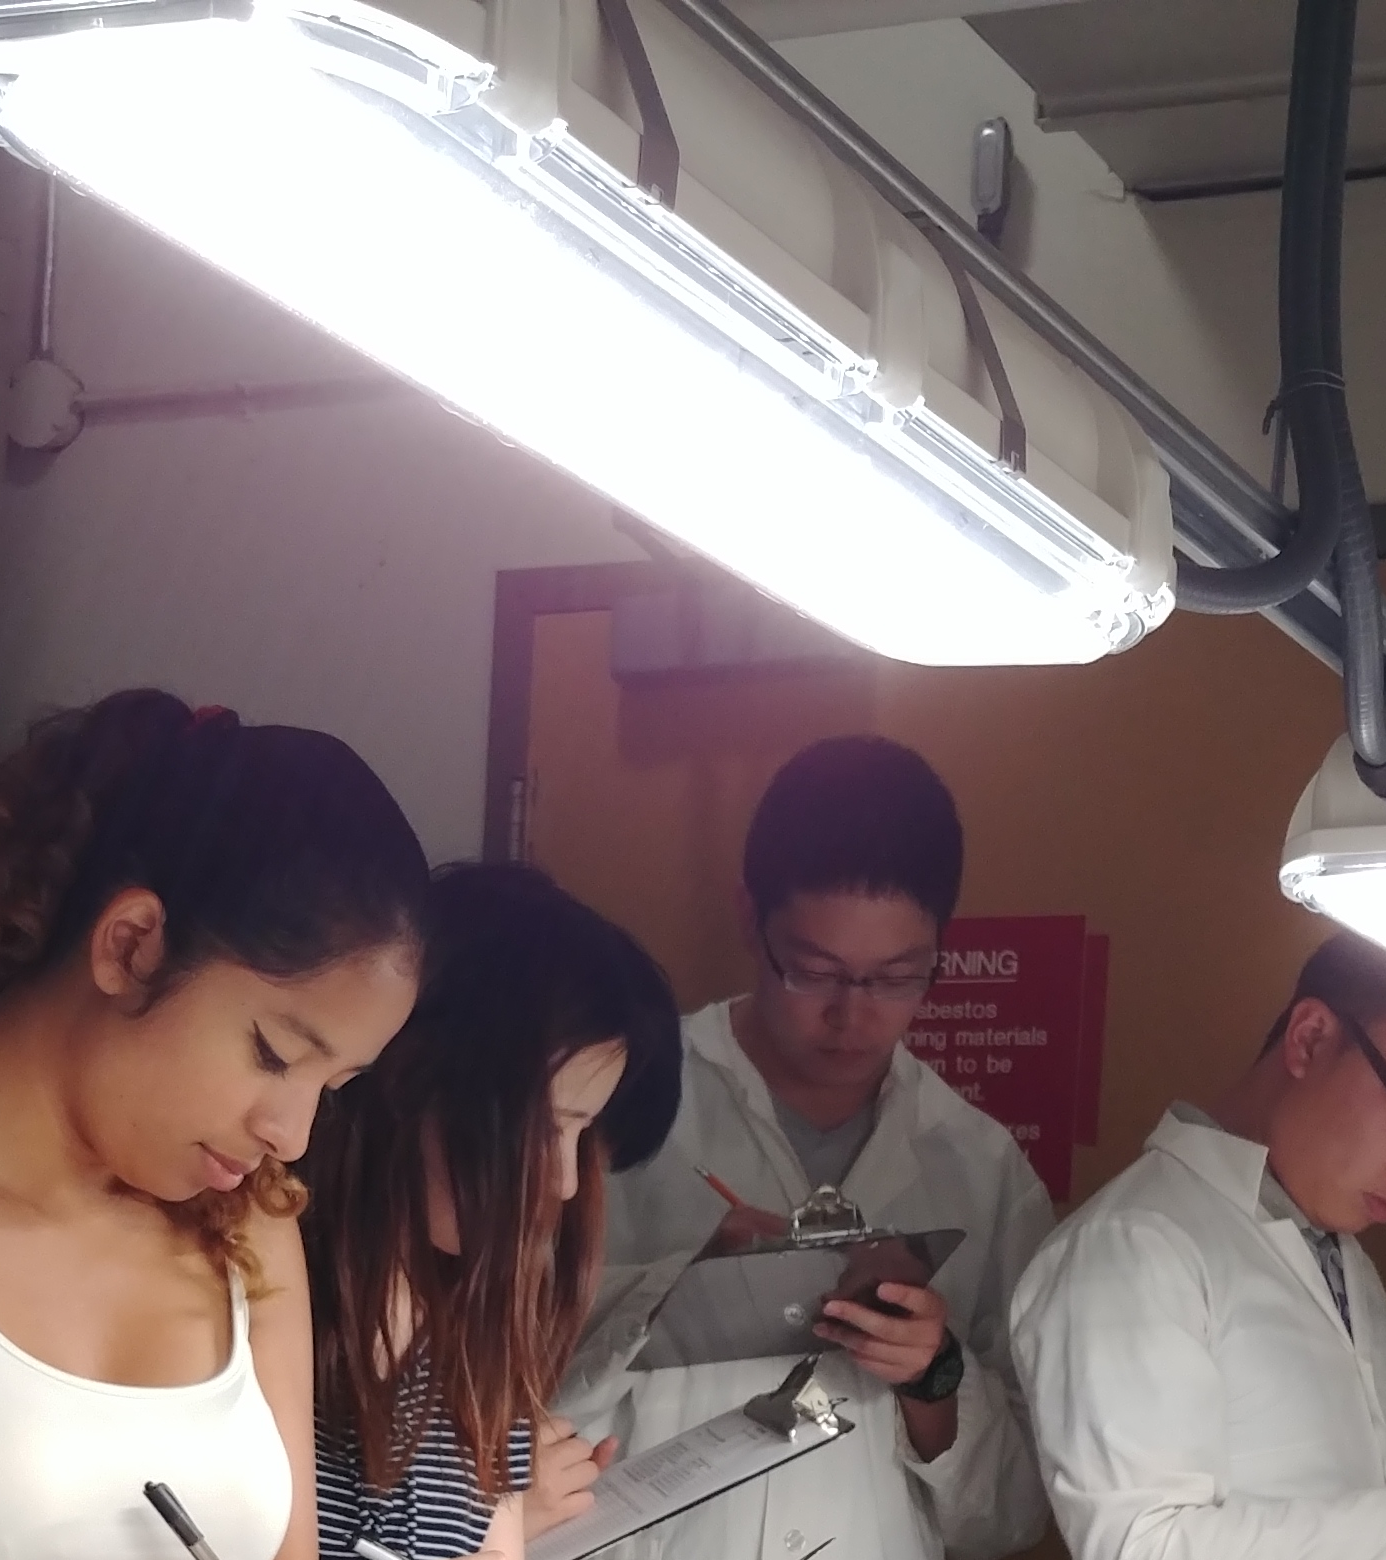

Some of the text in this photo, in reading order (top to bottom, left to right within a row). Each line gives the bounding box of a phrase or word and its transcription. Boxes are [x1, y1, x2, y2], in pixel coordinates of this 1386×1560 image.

[955, 1027, 1047, 1046] materials
[956, 1055, 978, 1074] to
[986, 1054, 1013, 1074] be
